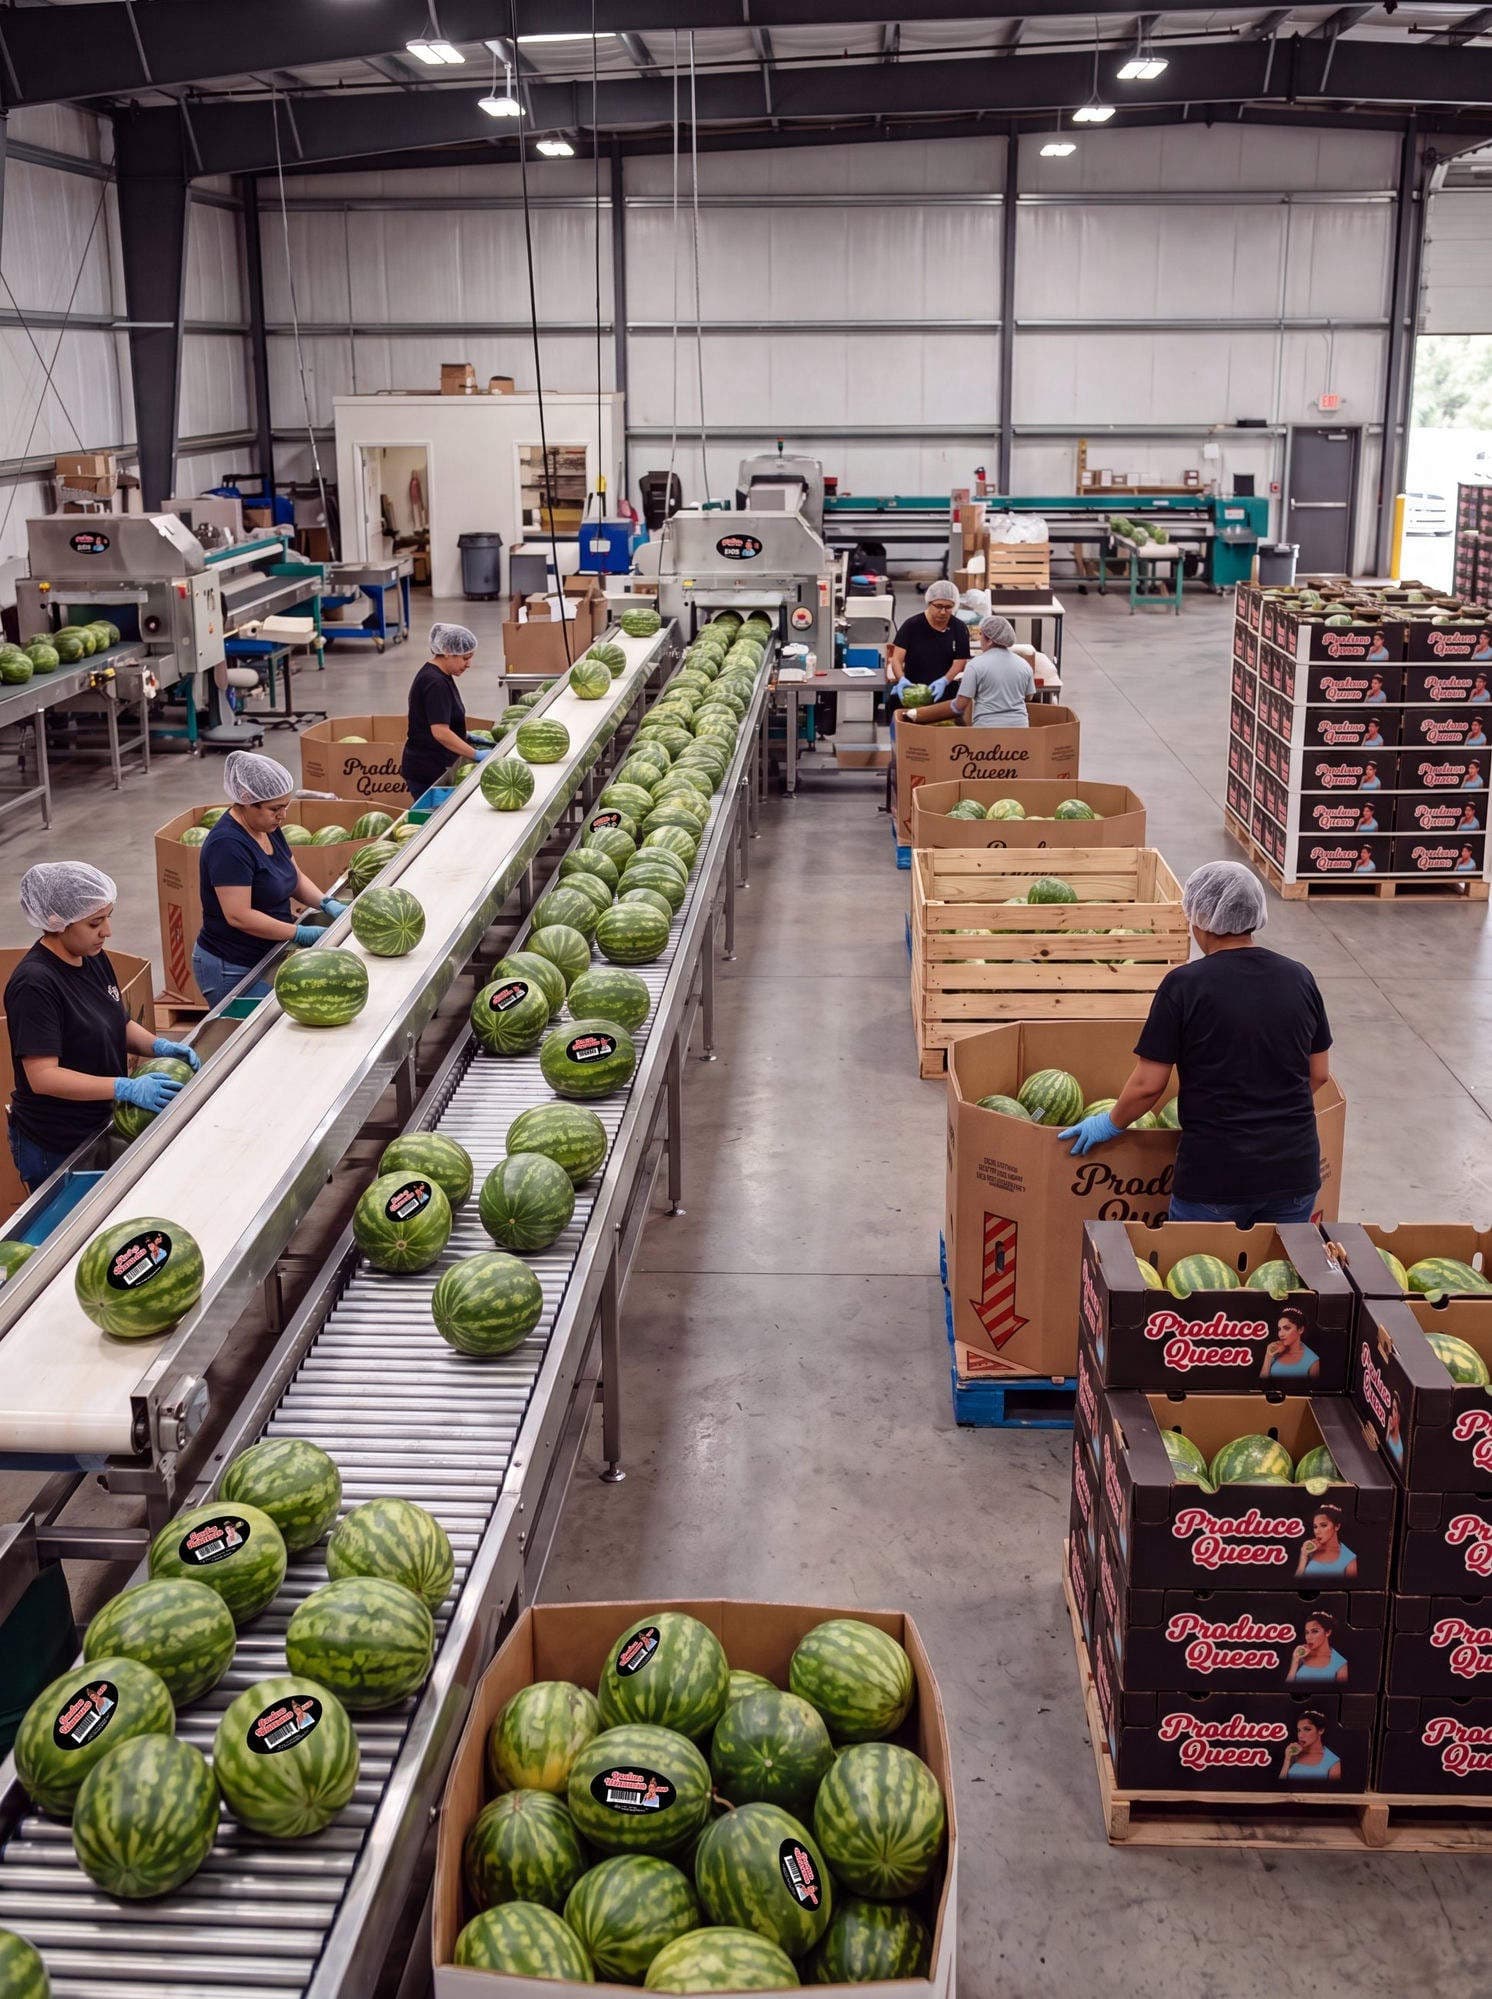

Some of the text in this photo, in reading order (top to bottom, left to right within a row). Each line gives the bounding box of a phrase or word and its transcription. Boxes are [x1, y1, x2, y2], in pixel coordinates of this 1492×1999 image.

[343, 757, 402, 776] Produ
[950, 743, 1030, 761] Produce
[962, 762, 1018, 779] Queen
[1071, 1162, 1174, 1197] Prod
[1098, 1198, 1170, 1229] Que
[1144, 1311, 1269, 1340] Produce
[1164, 1338, 1253, 1372] Queen
[1172, 1508, 1305, 1538] Produce
[1192, 1536, 1288, 1570] Queen
[1165, 1613, 1296, 1642] Produce
[1430, 1618, 1492, 1647] Pro
[1185, 1640, 1279, 1674] Queen
[1449, 1645, 1492, 1679] Qu
[1158, 1713, 1288, 1741] Produce
[1179, 1739, 1272, 1772] Queen
